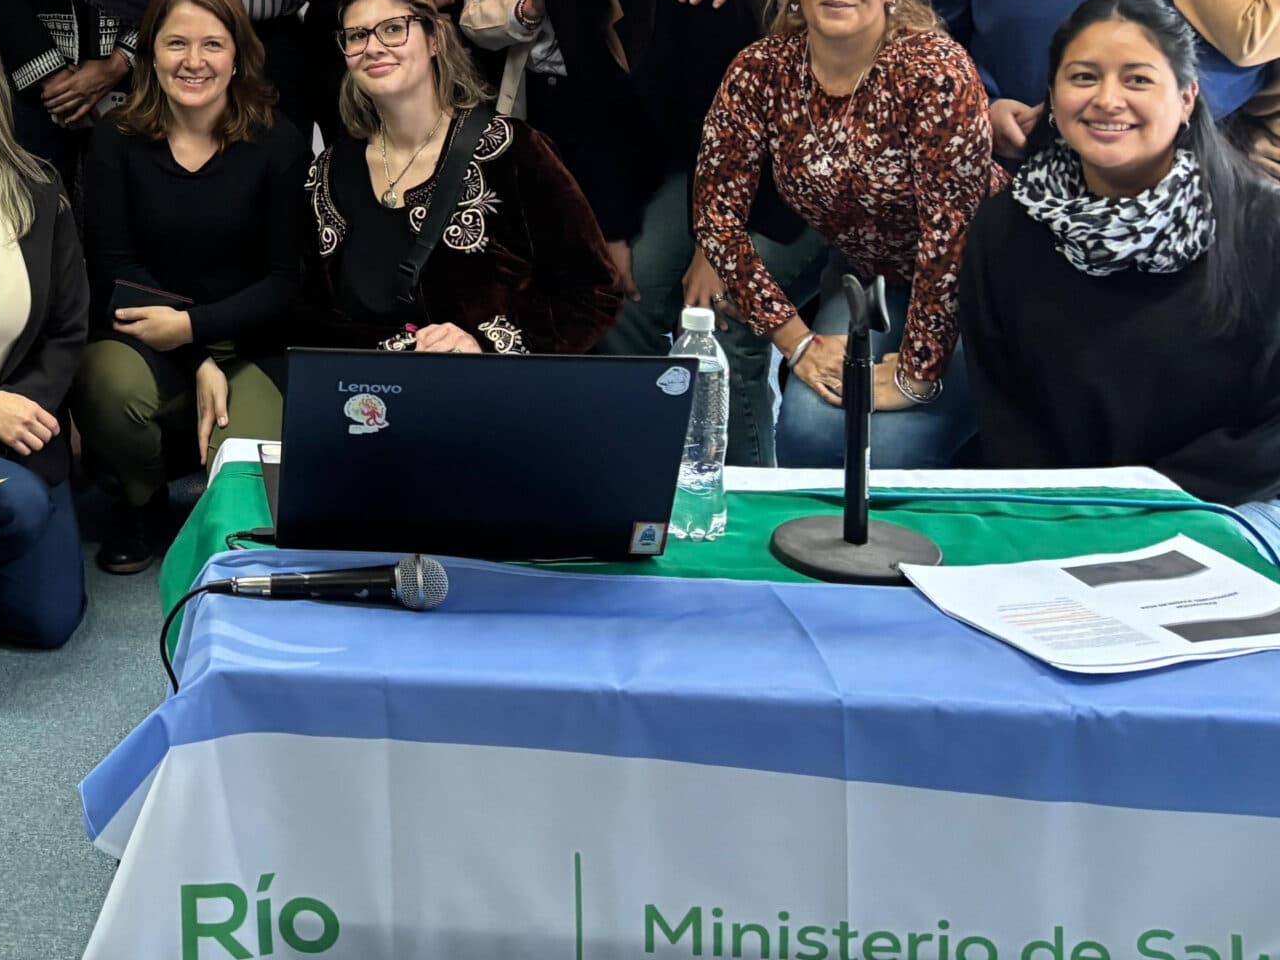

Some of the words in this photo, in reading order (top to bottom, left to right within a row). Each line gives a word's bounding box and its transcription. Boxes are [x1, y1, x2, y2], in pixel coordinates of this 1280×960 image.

[338, 381, 402, 394] Lenovo
[180, 872, 340, 960] Río
[644, 903, 999, 960] Ministerio
[1136, 929, 1270, 960] Sl
